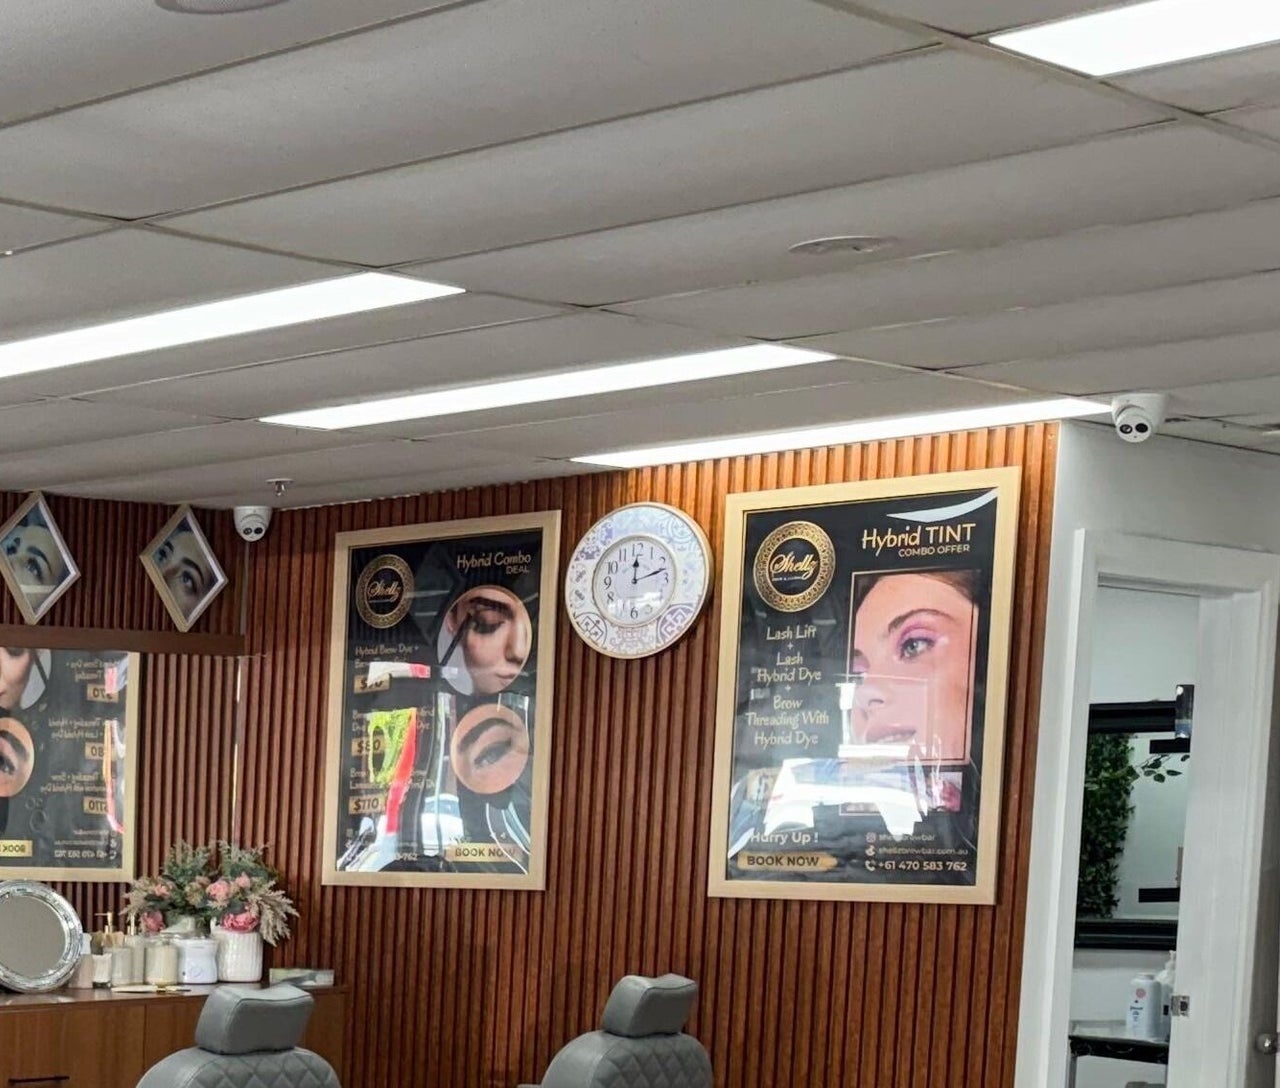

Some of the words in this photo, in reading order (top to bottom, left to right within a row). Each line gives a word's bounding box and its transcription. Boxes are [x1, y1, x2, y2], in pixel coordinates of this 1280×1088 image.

[861, 526, 921, 557] Hybrid
[926, 523, 977, 544] TINT
[898, 547, 936, 557] COMBO
[937, 544, 971, 554] OFFER
[457, 552, 493, 574] Hybrid
[494, 550, 531, 565] Combo
[506, 565, 530, 575] DEAL
[766, 627, 793, 640] Lash
[795, 625, 817, 639] Lift
[776, 652, 804, 666] Lash
[757, 667, 796, 687] Hybrid
[798, 667, 822, 687] Dye
[773, 695, 803, 710] Brow
[745, 712, 801, 730] Threading
[802, 710, 830, 726] With
[754, 733, 792, 750] Hybrid
[795, 731, 819, 749] Dye
[354, 798, 380, 810] $110
[750, 832, 787, 846] Hurry
[791, 832, 811, 847] Up
[455, 847, 485, 858] BOOK
[747, 855, 785, 866] BOOK
[786, 856, 821, 867] NOW
[878, 860, 896, 871] +61
[898, 861, 920, 871] 470
[923, 861, 944, 872] 583
[946, 861, 969, 872] 762
